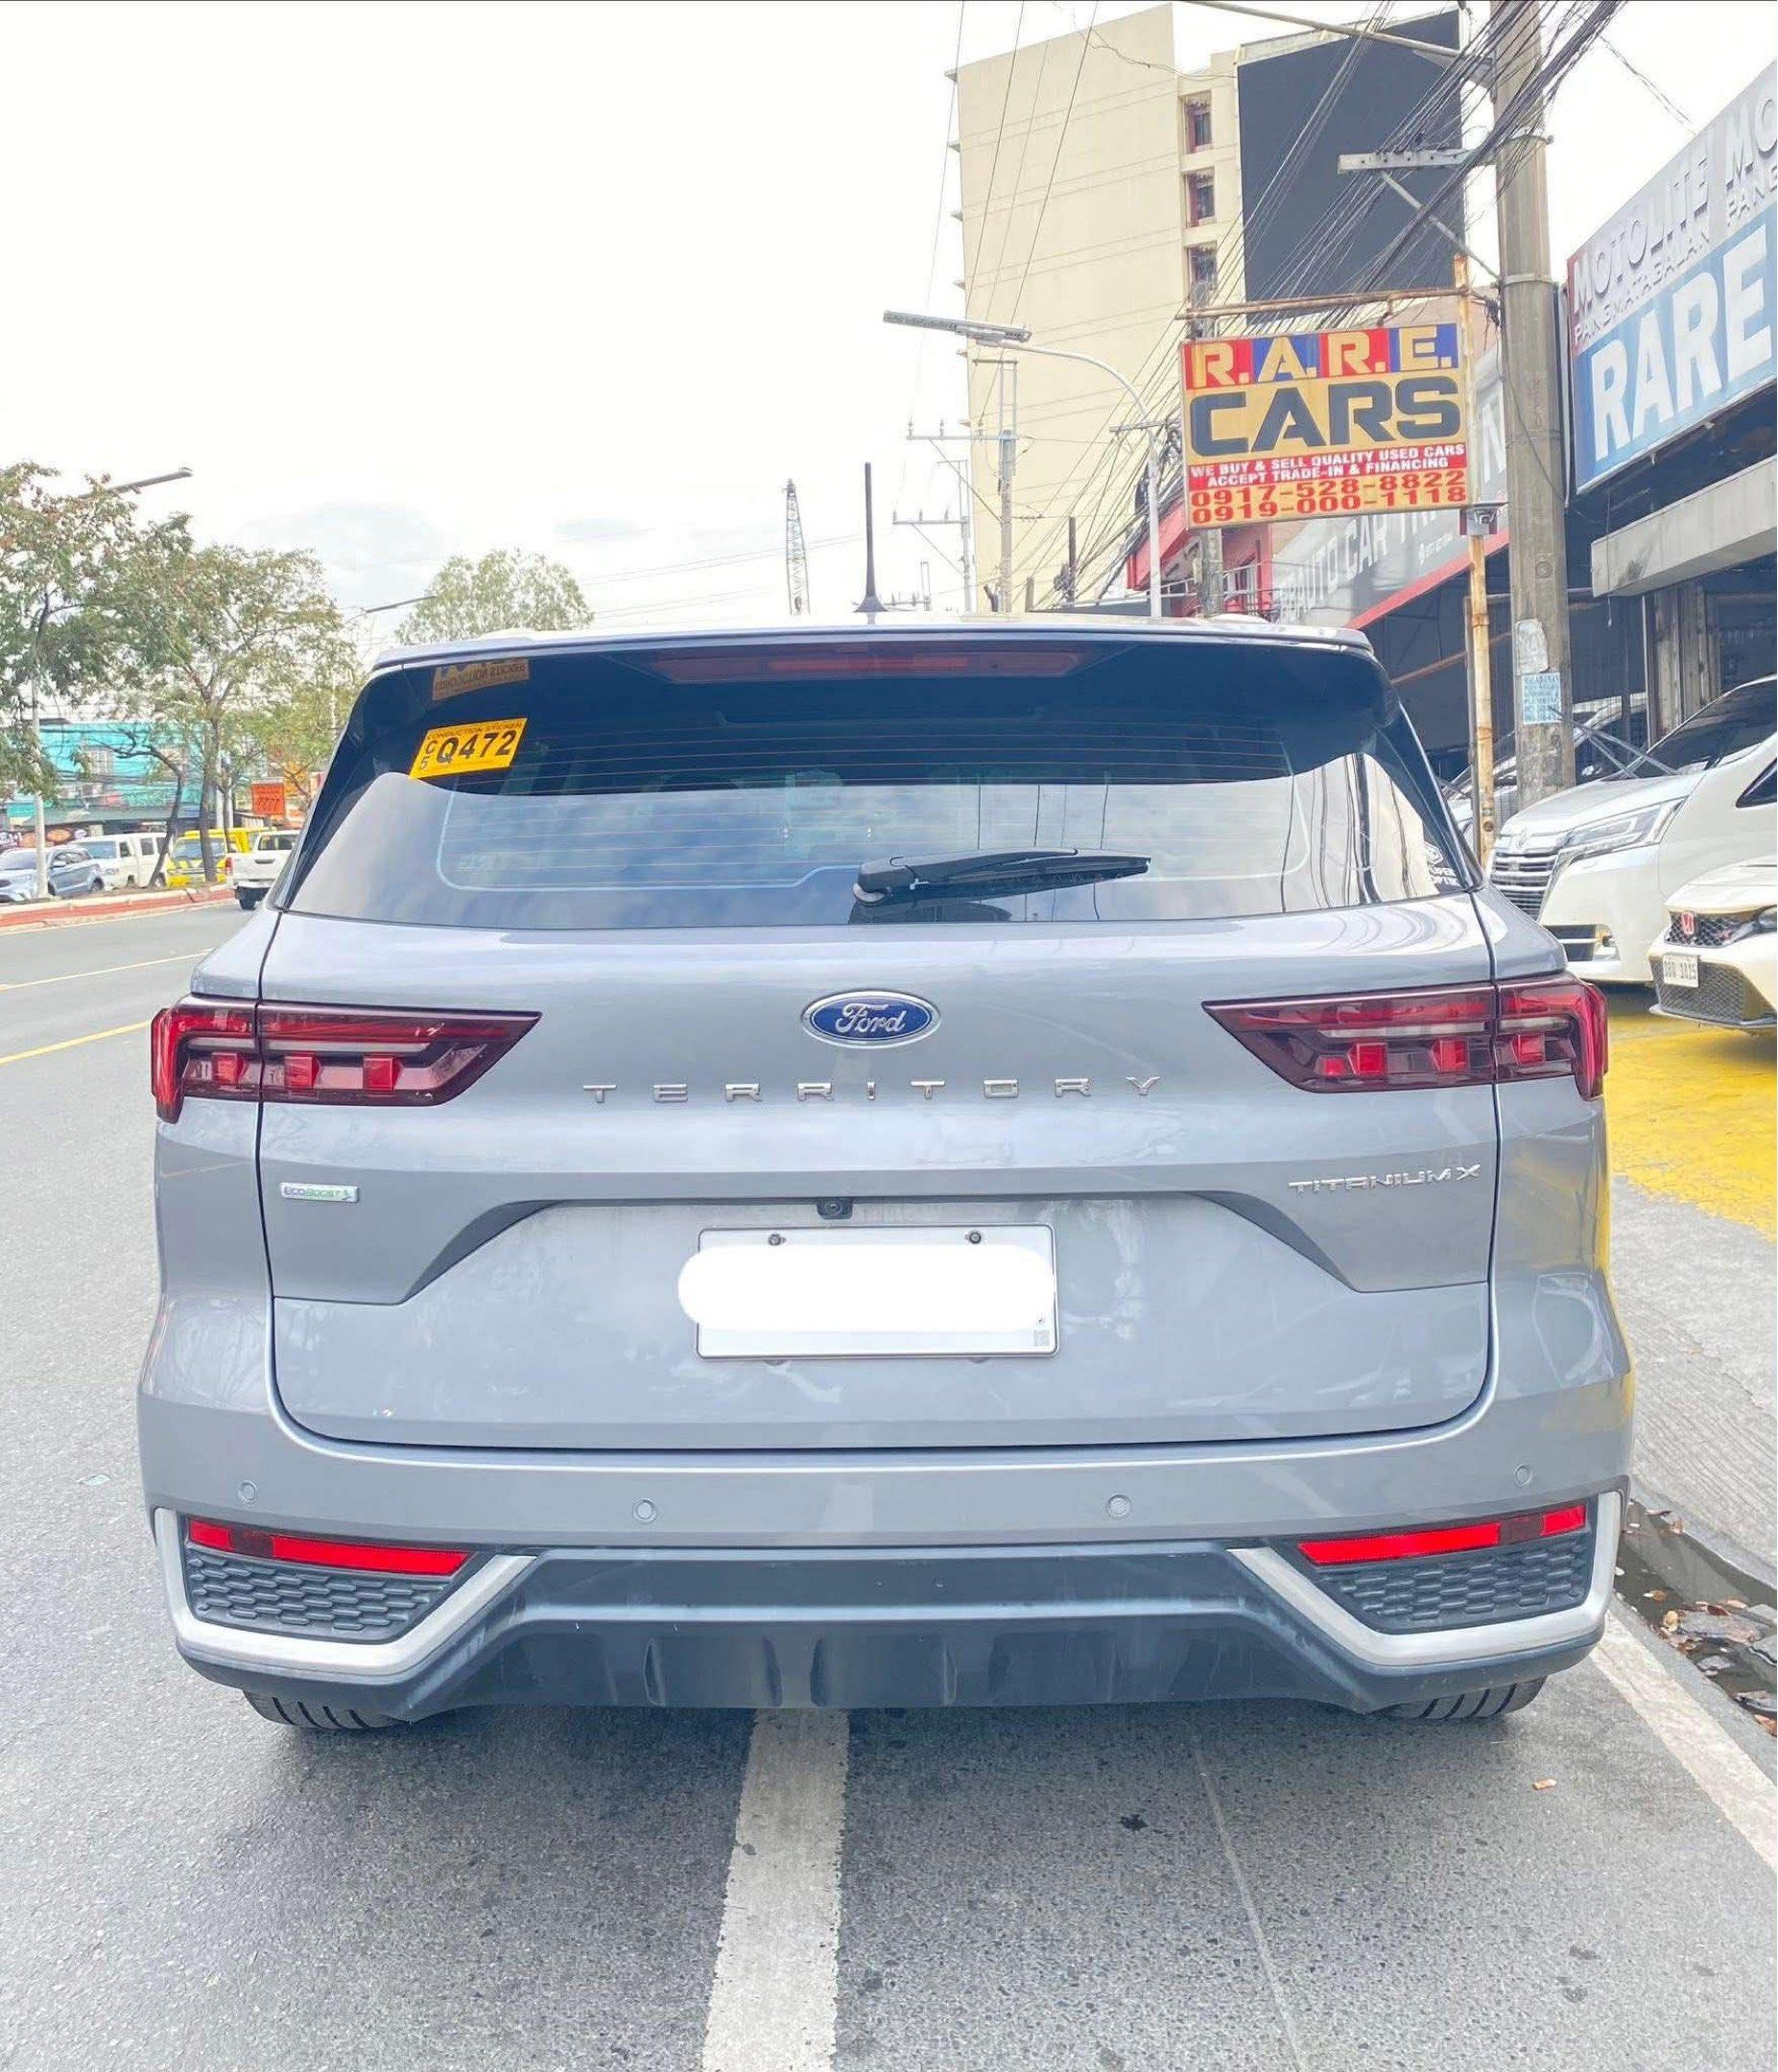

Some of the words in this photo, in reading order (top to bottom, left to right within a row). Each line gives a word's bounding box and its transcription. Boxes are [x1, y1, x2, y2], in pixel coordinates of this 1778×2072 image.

[1574, 149, 1709, 317] MOTOLITE
[1193, 324, 1453, 388] R.A.R.E.
[1591, 224, 1772, 461] RARE
[1190, 375, 1461, 457] CARS
[1191, 465, 1215, 478] WE
[1220, 461, 1248, 476] BUY
[1255, 459, 1266, 472] &
[1271, 456, 1305, 470] SELL
[1312, 450, 1374, 467] QUALITY
[1379, 447, 1418, 460] USED
[1423, 444, 1465, 459] CARS
[1208, 472, 1267, 487] ACCEPT
[1273, 466, 1343, 483] TRADE-IN
[1350, 462, 1360, 475] &
[1366, 457, 1449, 474] FINANCING
[1191, 470, 1465, 507] 0917-528-8822
[1192, 486, 1466, 525] 0919-000-1118
[437, 730, 517, 765] Q472
[834, 1002, 907, 1035] Ford
[581, 1075, 1161, 1104] TERRITORY
